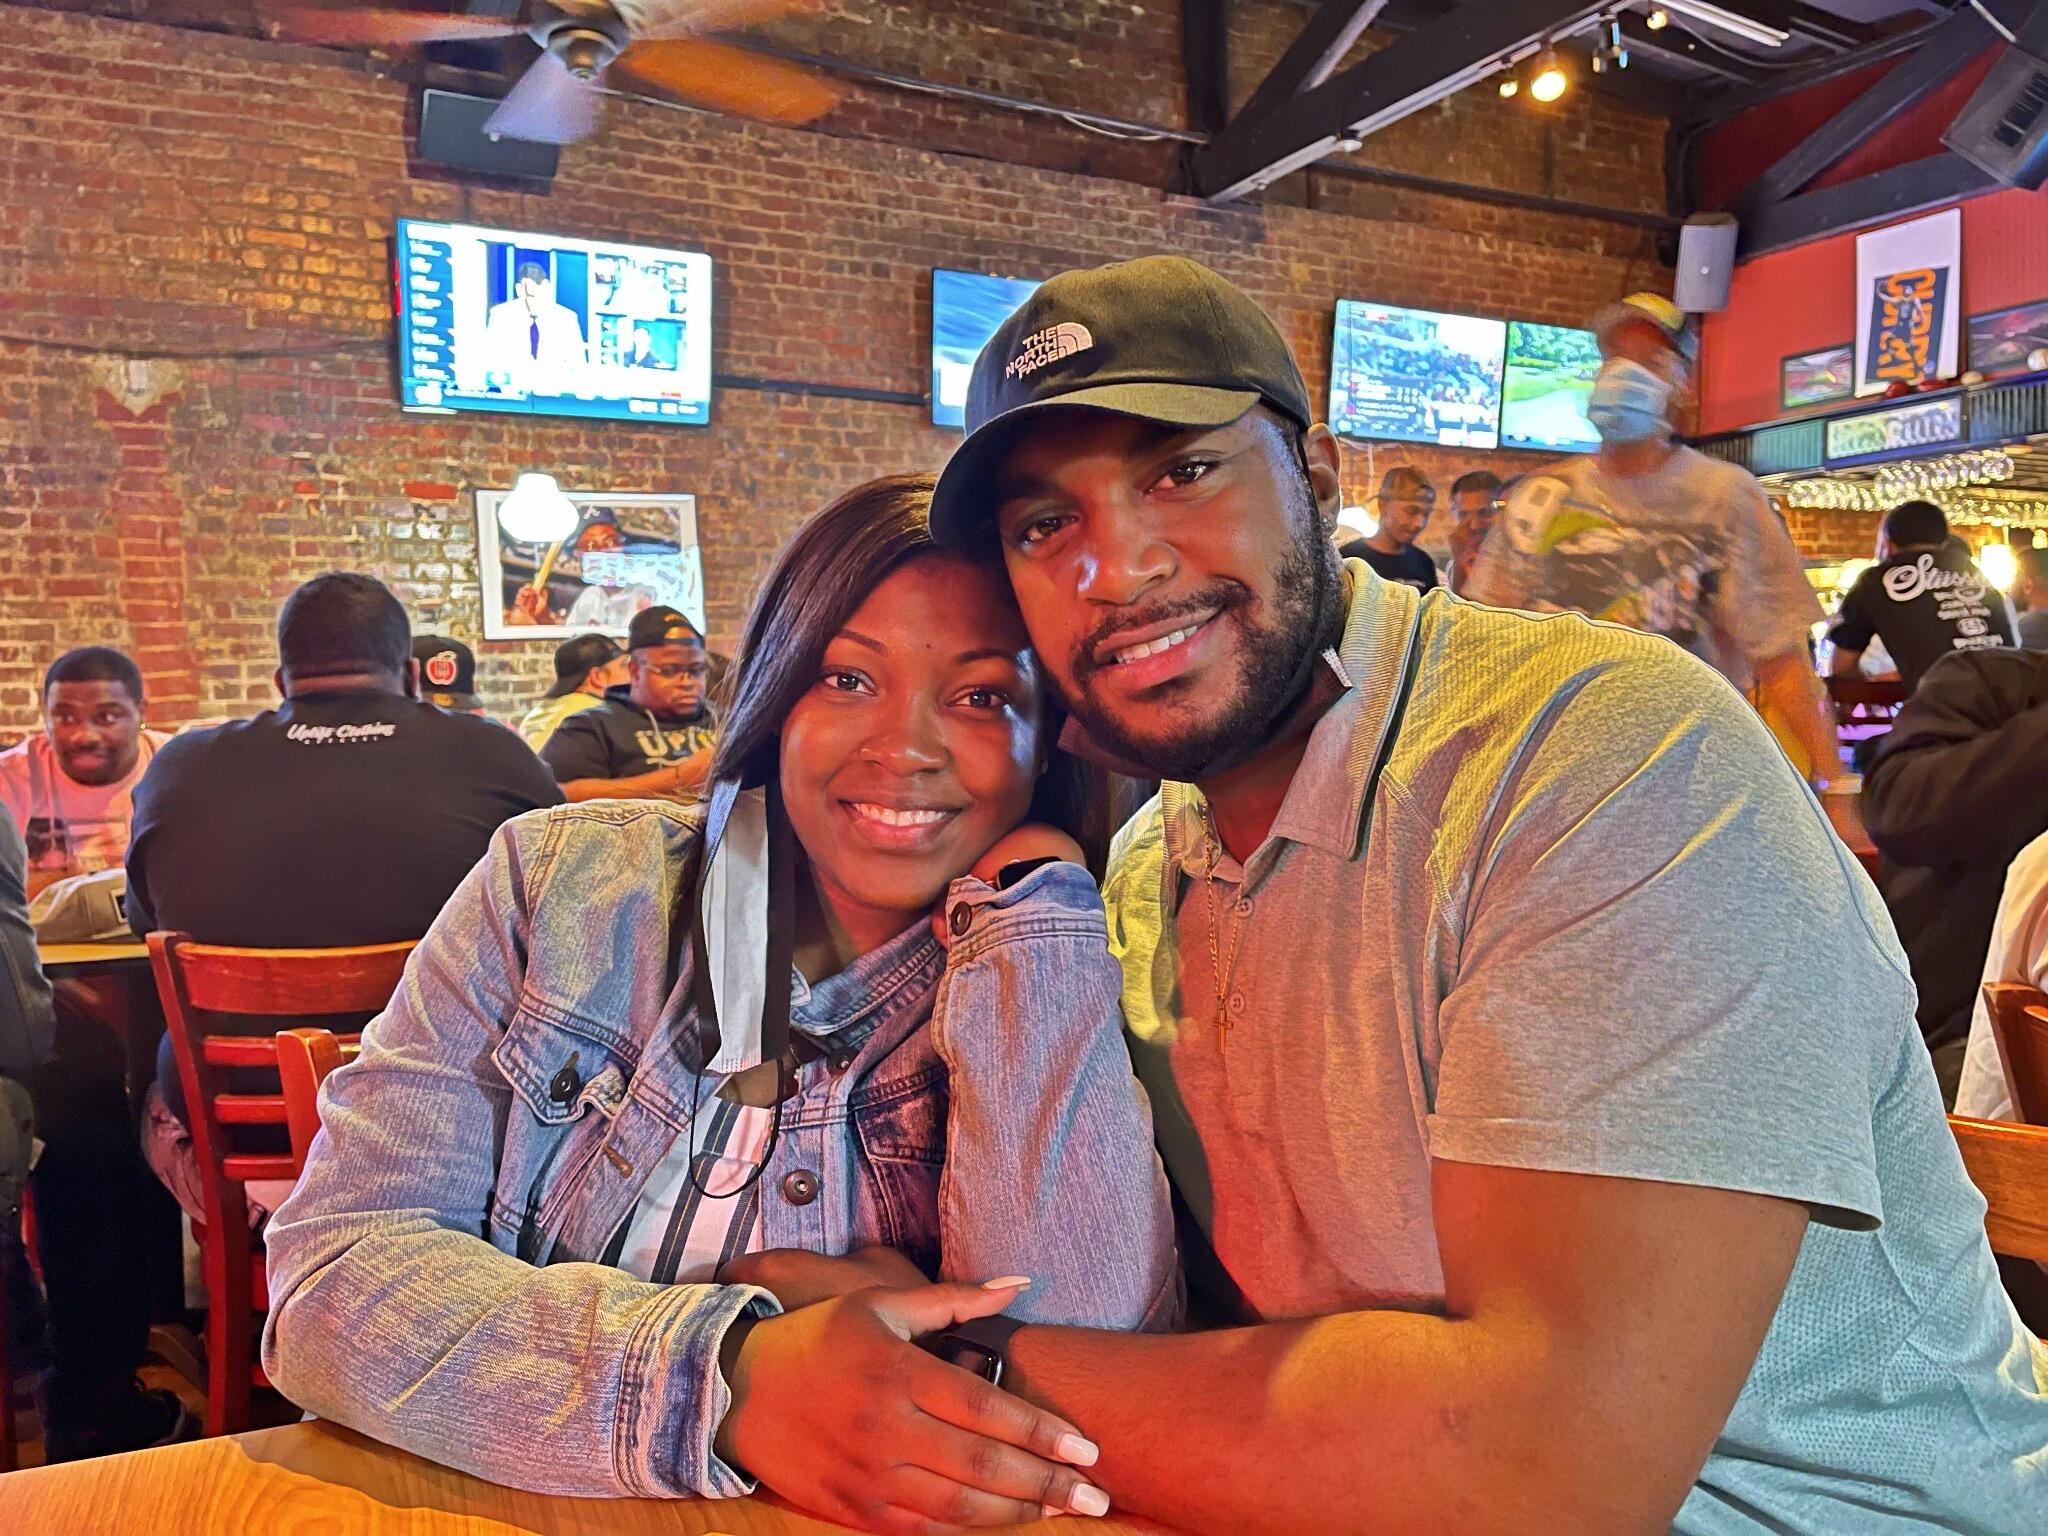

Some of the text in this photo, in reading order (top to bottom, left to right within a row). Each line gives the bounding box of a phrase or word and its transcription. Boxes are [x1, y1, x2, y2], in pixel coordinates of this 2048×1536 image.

[1022, 326, 1058, 350] THE
[1005, 334, 1059, 379] NORTH
[1018, 350, 1058, 379] FACE
